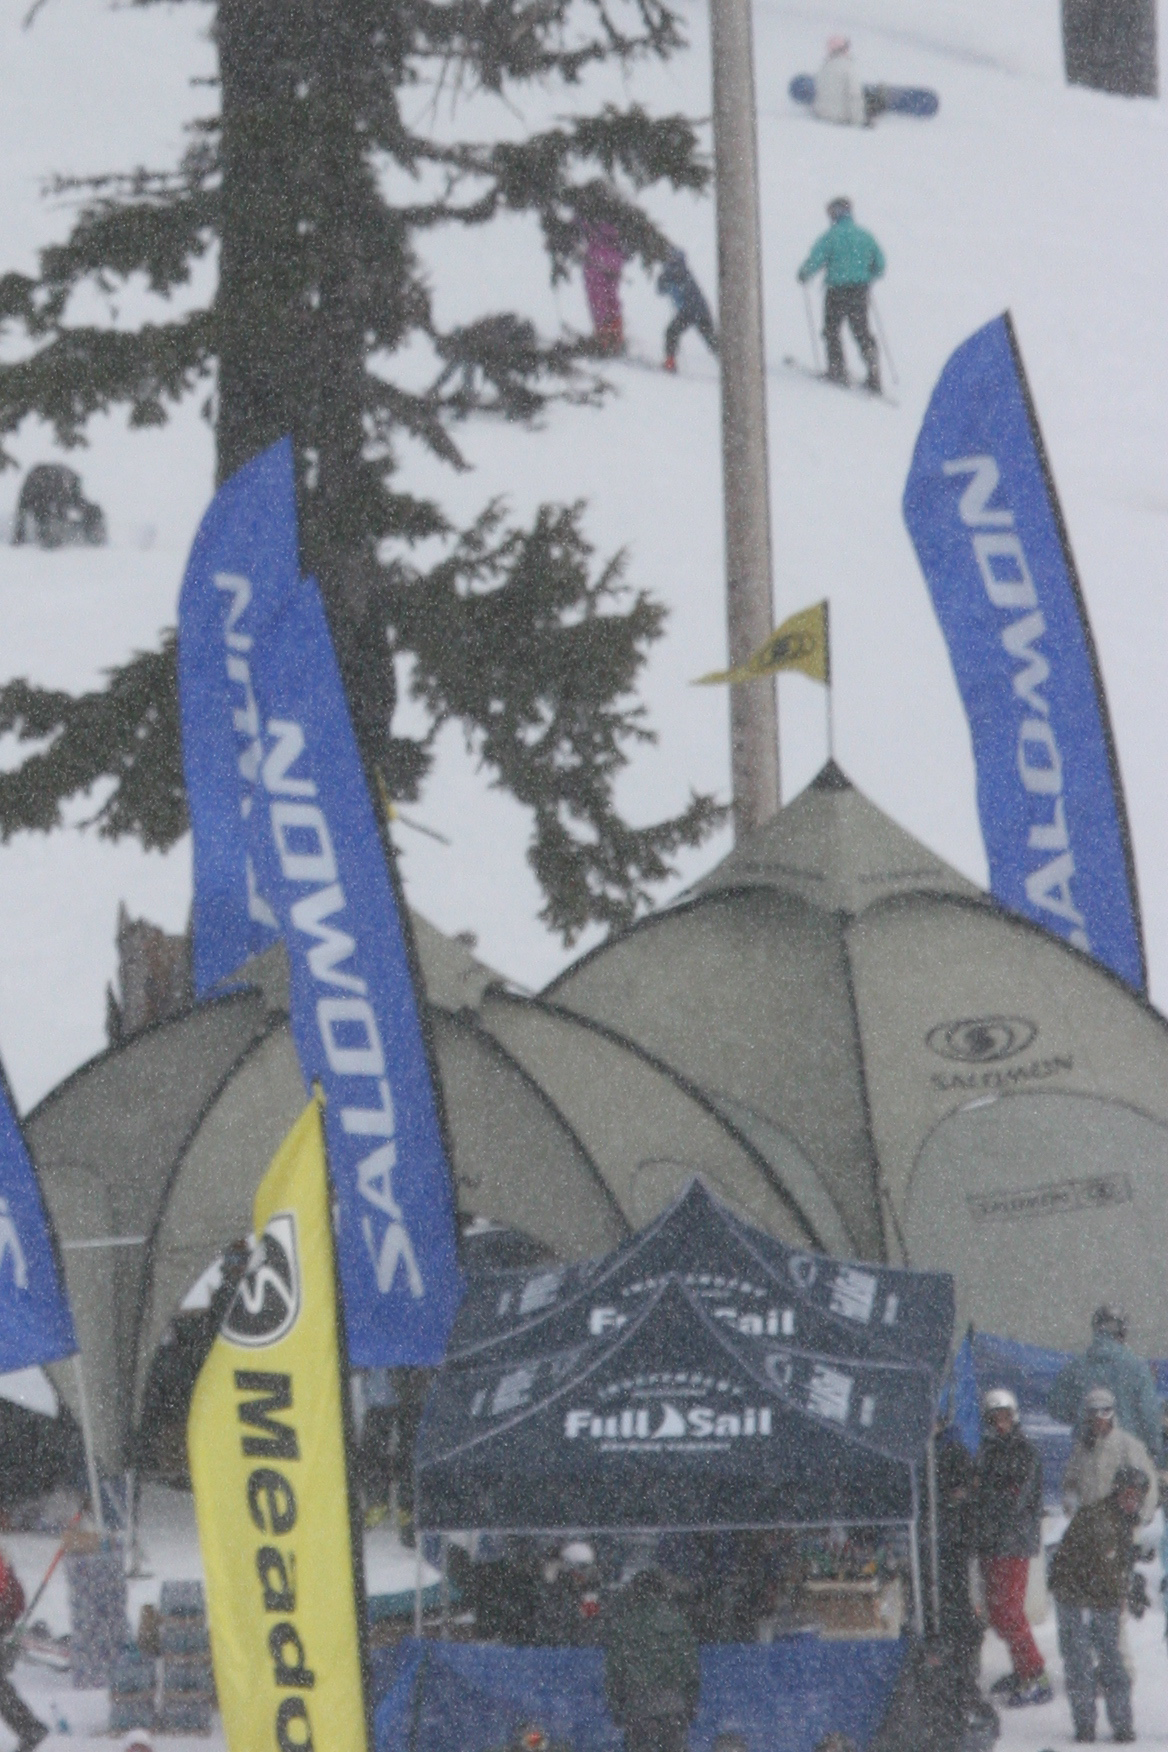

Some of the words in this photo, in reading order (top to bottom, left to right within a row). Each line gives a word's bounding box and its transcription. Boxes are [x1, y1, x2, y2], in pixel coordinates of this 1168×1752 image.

[943, 452, 1091, 954] ALOMON
[262, 718, 424, 1299] SALOMON
[564, 1408, 649, 1439] Full
[686, 1406, 773, 1437] Sail
